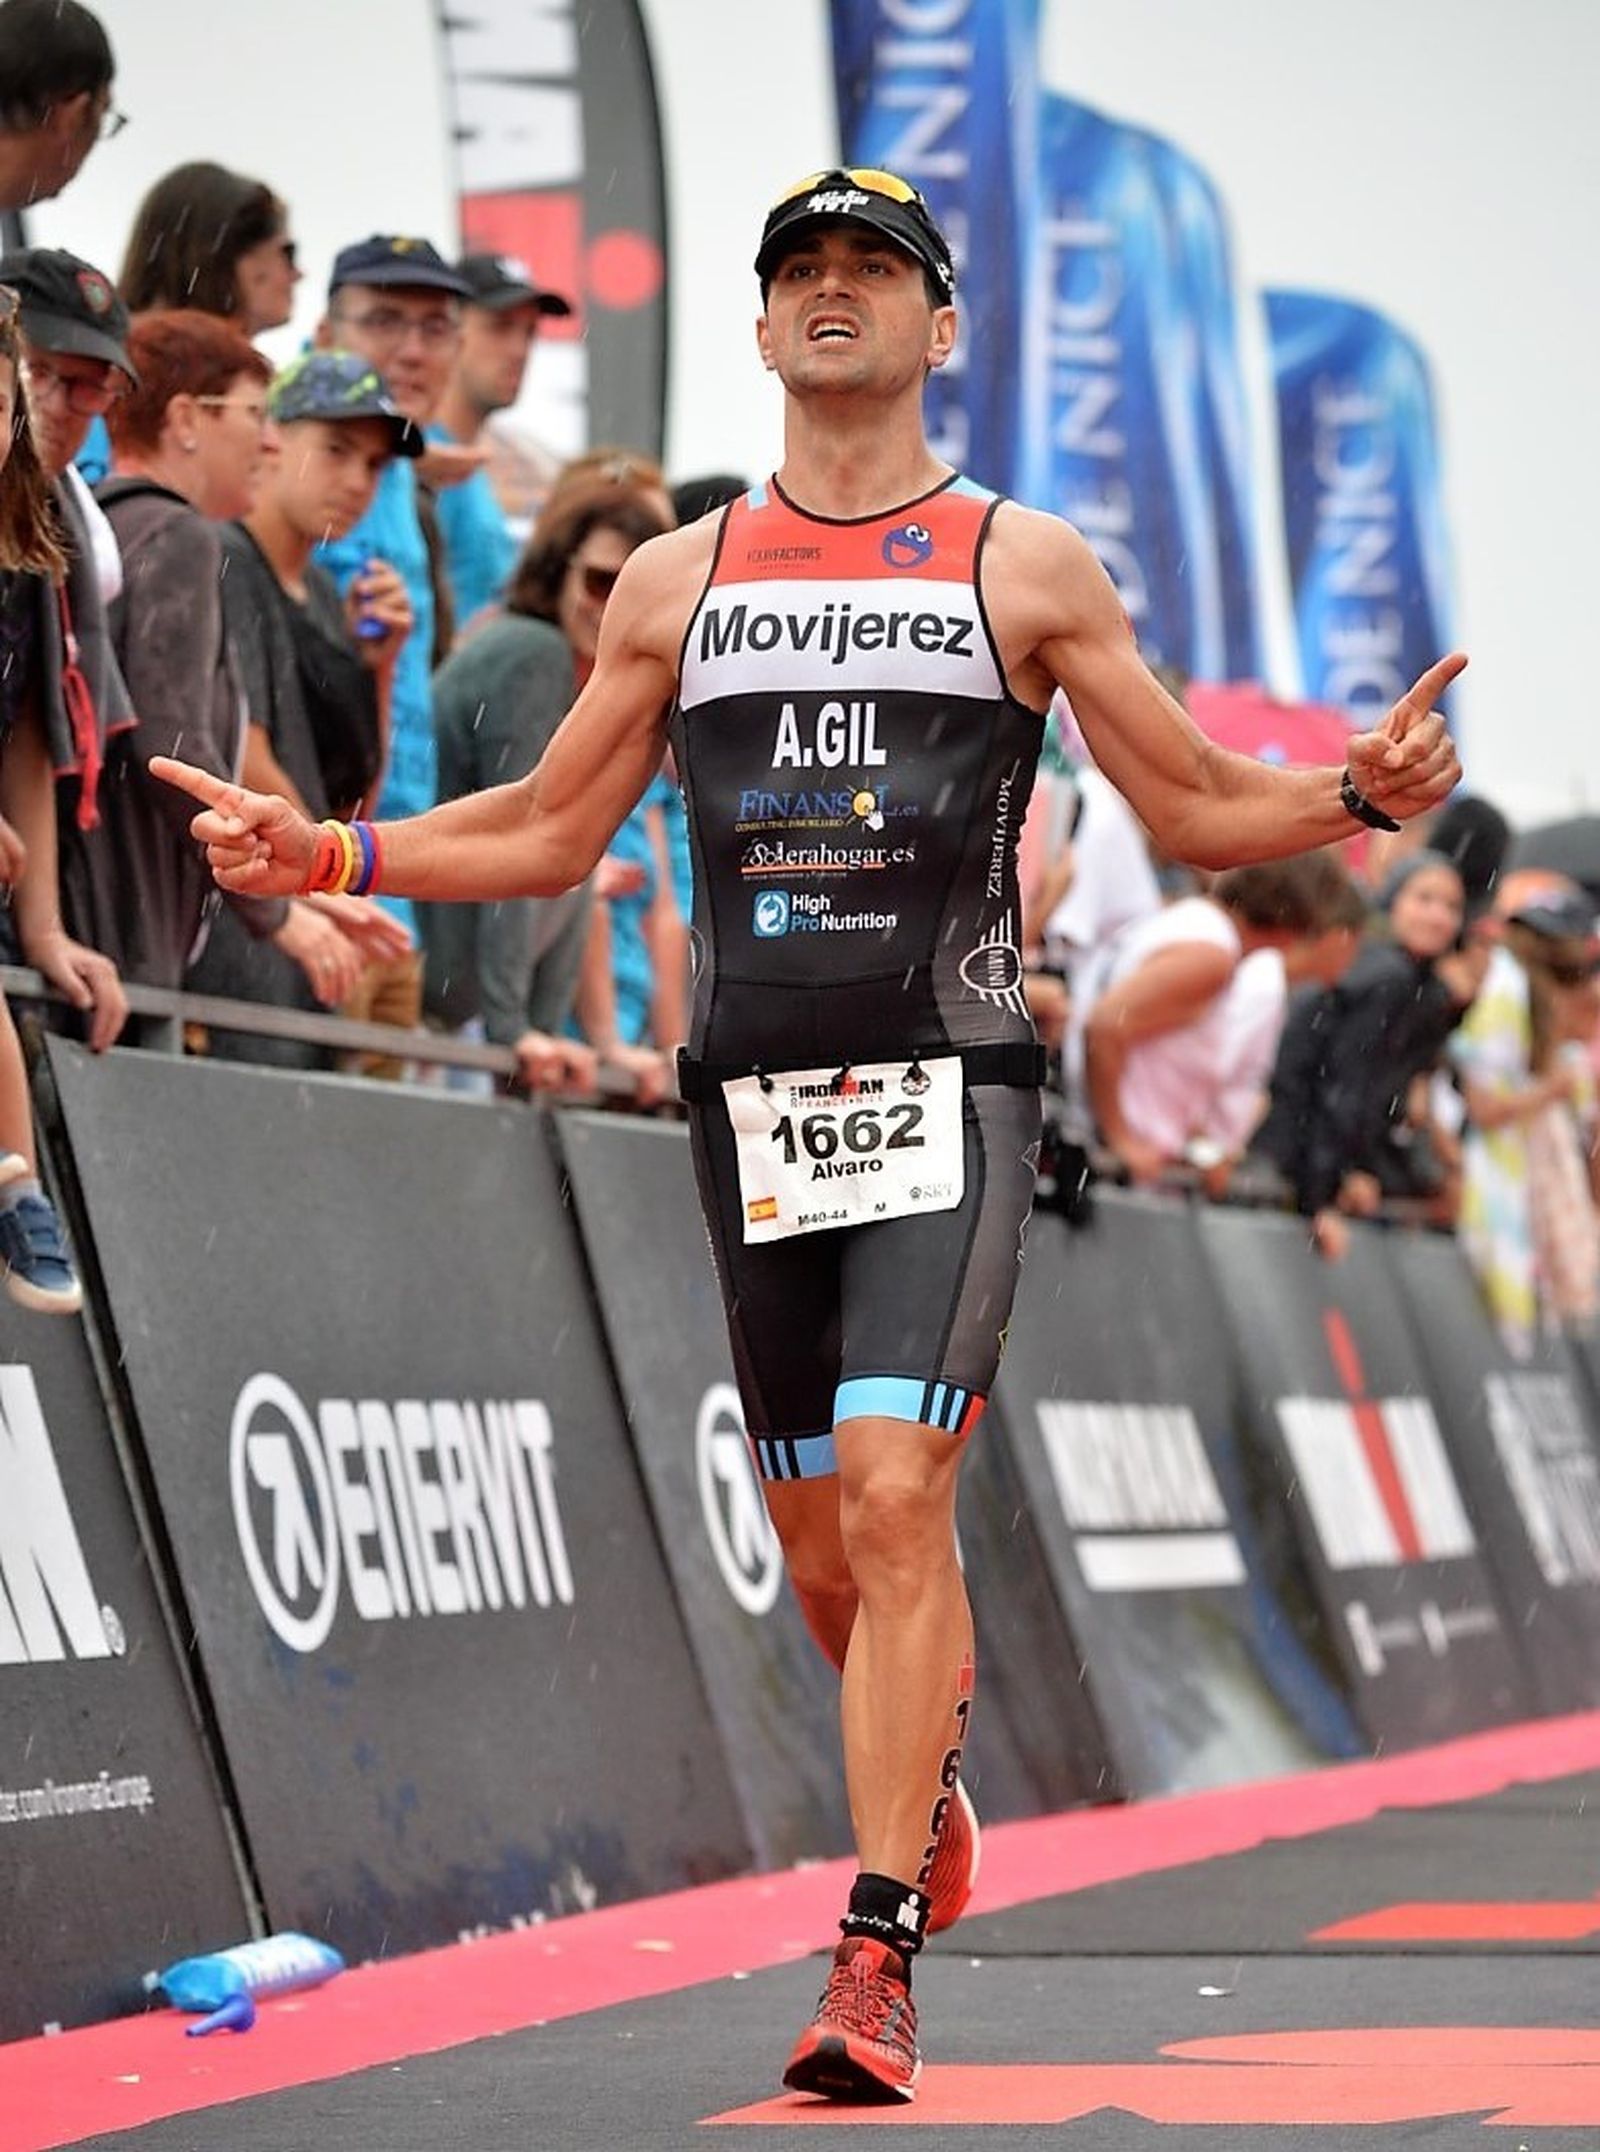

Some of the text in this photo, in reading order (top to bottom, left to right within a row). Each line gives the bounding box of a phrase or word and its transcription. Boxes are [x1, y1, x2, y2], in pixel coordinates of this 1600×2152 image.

[700, 604, 974, 664] Movijerez
[772, 701, 886, 768] A.GIL
[986, 777, 1012, 899] MOVIJEREZ
[791, 912, 897, 931] ProNutrition
[792, 894, 831, 914] High
[988, 950, 1006, 987] MINI
[772, 1104, 925, 1164] 1662
[811, 1158, 883, 1181] Alvaro
[318, 1400, 574, 1619] ENERVIT
